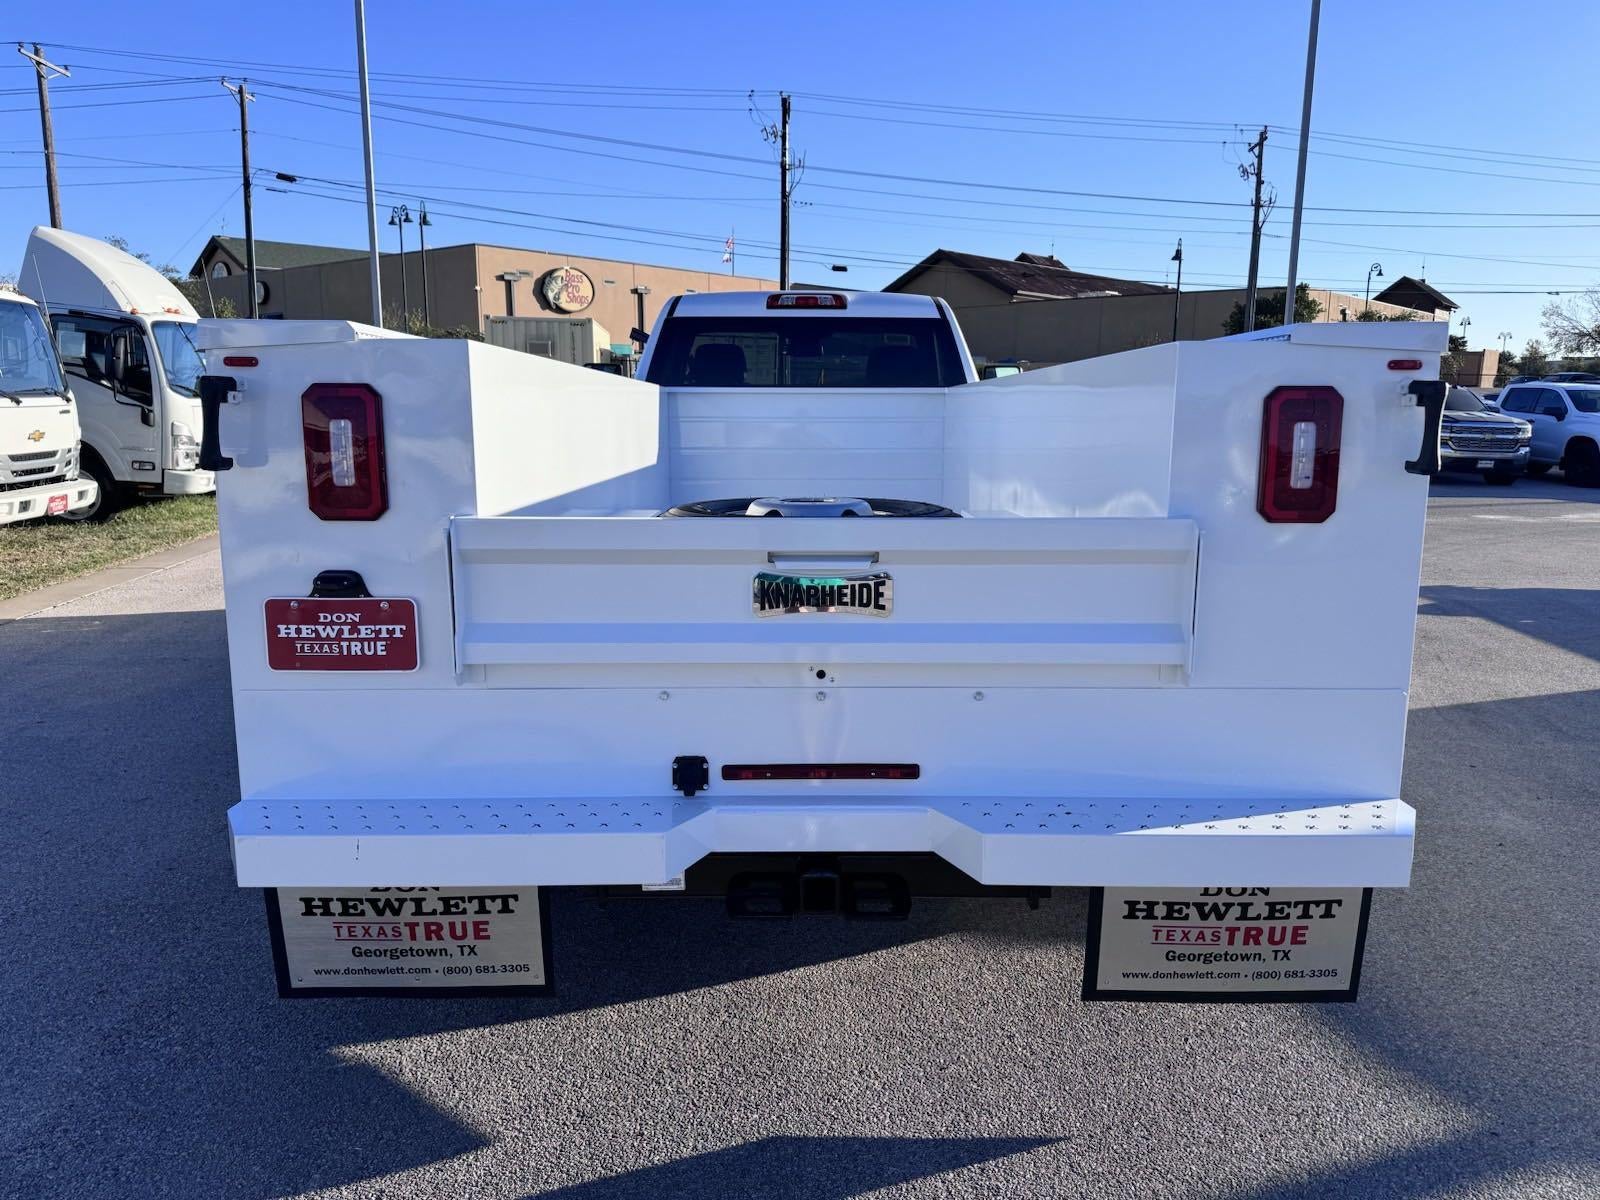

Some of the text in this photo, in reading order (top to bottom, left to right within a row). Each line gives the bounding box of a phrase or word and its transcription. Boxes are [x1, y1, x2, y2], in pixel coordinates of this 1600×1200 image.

[565, 270, 584, 284] Bass
[566, 282, 580, 295] Pro
[566, 292, 590, 307] Shops
[759, 579, 887, 611] KNAPHEIDE
[318, 613, 362, 623] DON
[277, 624, 406, 639] HEWLETT
[298, 894, 519, 917] HEWLETT
[1122, 899, 1343, 921] HEWLETT
[351, 944, 478, 960] Georgetown, TX
[1165, 949, 1292, 965] Georgetown, TX
[314, 964, 530, 977] www.donhewlett.com (800) 681-3305
[1122, 968, 1338, 981] www.donhewlett.com (800) 681-3305
